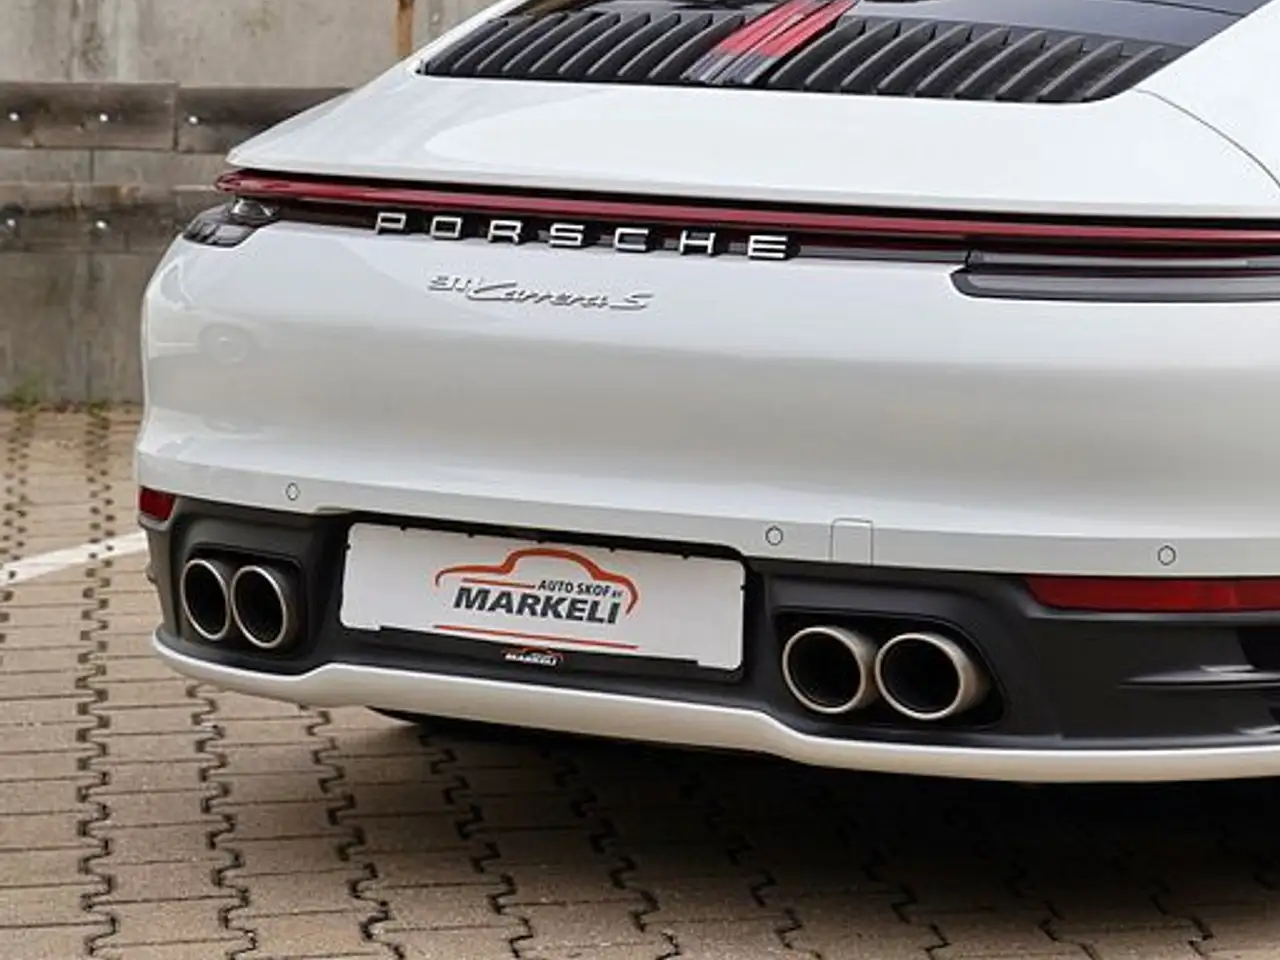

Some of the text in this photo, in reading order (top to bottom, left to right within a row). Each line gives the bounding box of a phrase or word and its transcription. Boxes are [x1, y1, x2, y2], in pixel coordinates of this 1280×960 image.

[374, 211, 789, 260] PORSCHE
[466, 281, 609, 309] Carrera
[610, 293, 655, 310] S
[537, 579, 574, 594] AUTO
[577, 583, 612, 597] SKOF
[454, 587, 622, 625] MARKELI
